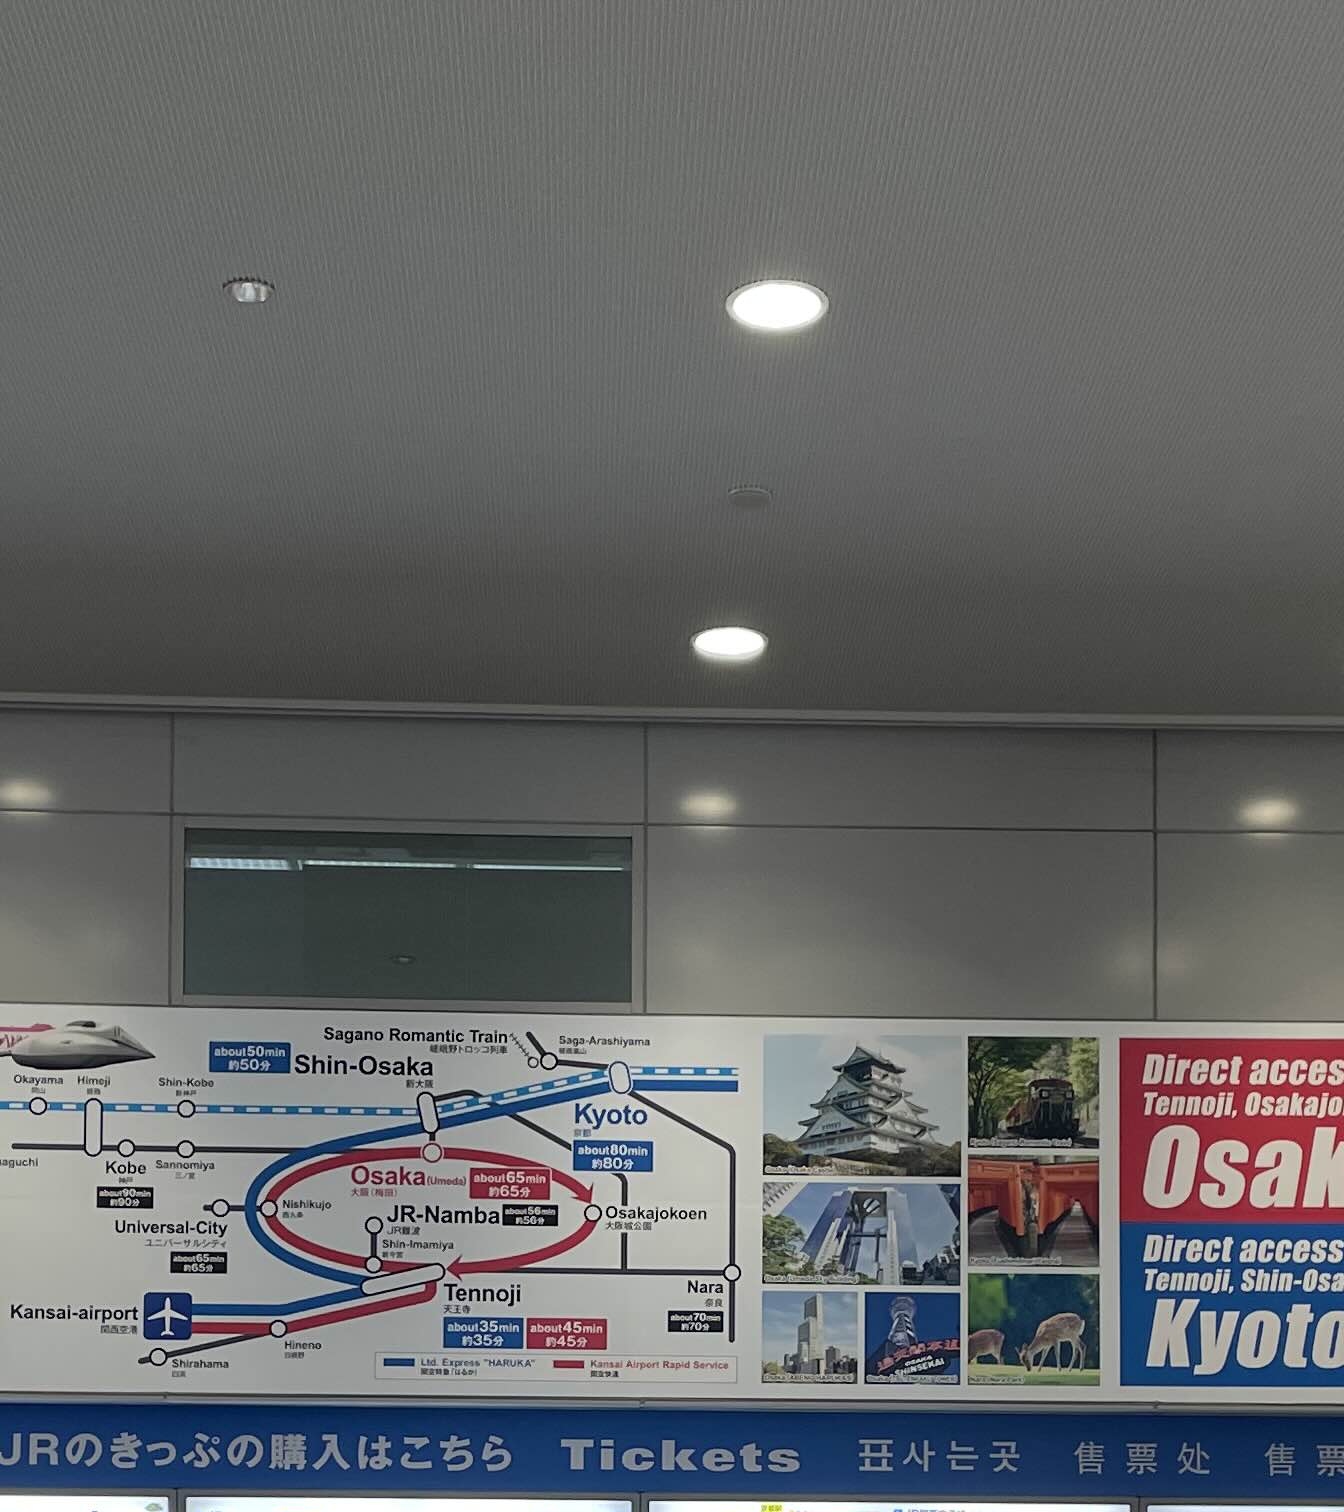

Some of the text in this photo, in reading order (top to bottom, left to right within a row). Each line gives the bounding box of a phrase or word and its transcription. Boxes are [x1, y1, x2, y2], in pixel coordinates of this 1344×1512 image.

[324, 1028, 508, 1043] Sagano Romantic Train
[559, 1036, 651, 1048] Saga-Arashiyama
[295, 1054, 433, 1076] Shin-Osaka
[1142, 1054, 1243, 1085] Direct
[13, 1075, 64, 1087] Okayama
[77, 1076, 111, 1088] Himeji
[158, 1077, 214, 1088] Shin-Kobe
[1144, 1092, 1238, 1119] Tennoji,
[575, 1103, 648, 1130] Kyoto
[106, 1161, 146, 1174] Kobe
[156, 1160, 215, 1171] Sannomiya
[351, 1166, 425, 1185] Osaka
[282, 1199, 331, 1210] Nishikujo
[387, 1205, 500, 1224] JR-Namba
[606, 1206, 707, 1222] Osakajokoen
[115, 1220, 228, 1237] Universal-City
[382, 1239, 454, 1251] Shin-Imamiya
[1143, 1234, 1234, 1264] Direct
[1239, 1239, 1344, 1264] access
[687, 1281, 724, 1294] Nara
[1145, 1269, 1235, 1294] Tennoji,
[443, 1283, 521, 1306] Tennoji
[10, 1304, 139, 1324] Kansai-airport
[284, 1341, 322, 1350] Hineno
[171, 1358, 230, 1370] Shirahama
[560, 1438, 801, 1472] Tickets
